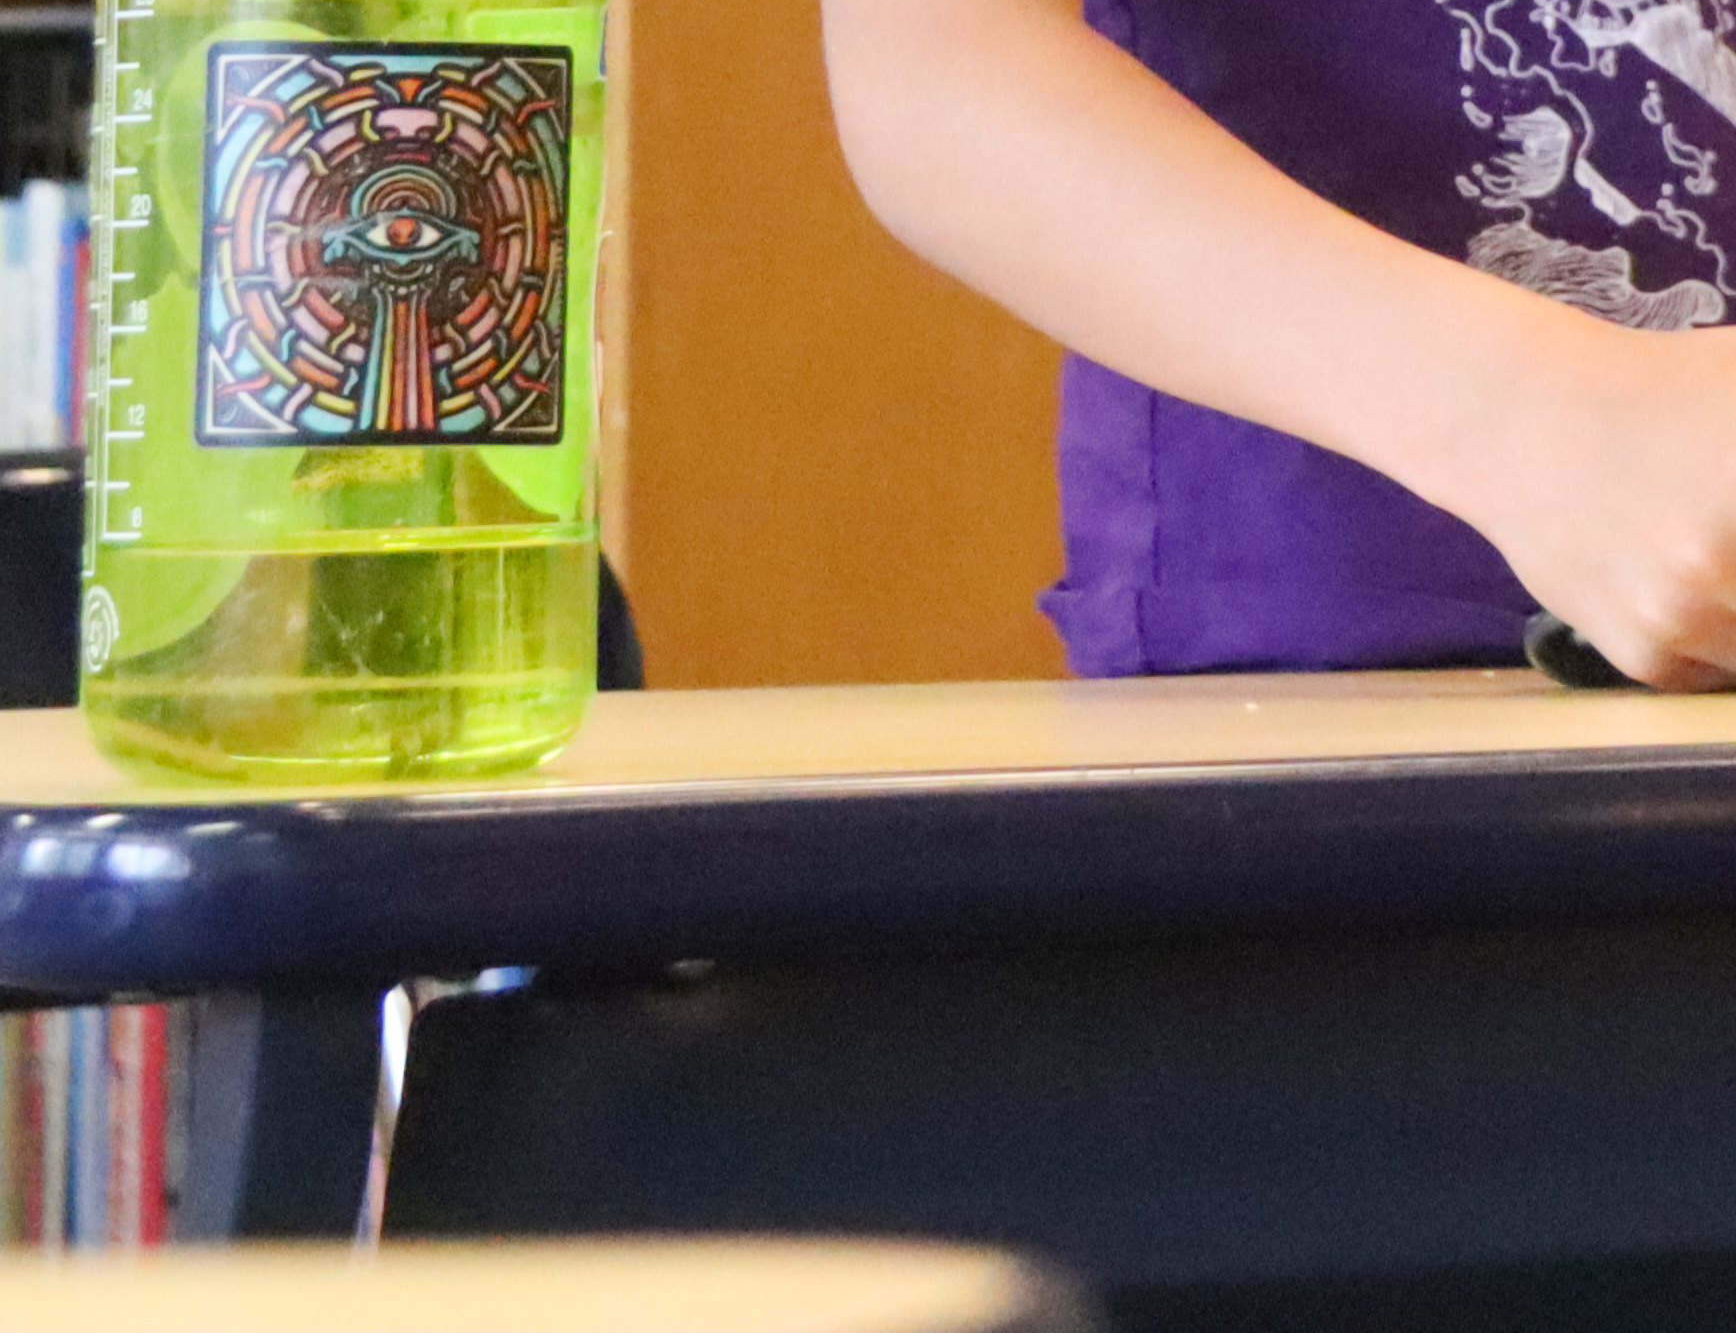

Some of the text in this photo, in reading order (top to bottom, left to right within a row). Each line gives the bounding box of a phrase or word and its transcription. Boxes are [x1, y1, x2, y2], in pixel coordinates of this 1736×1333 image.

[133, 88, 153, 111] 24
[130, 194, 151, 217] 20
[129, 299, 148, 323] 16
[128, 403, 146, 426] 12
[131, 506, 143, 528] 8
